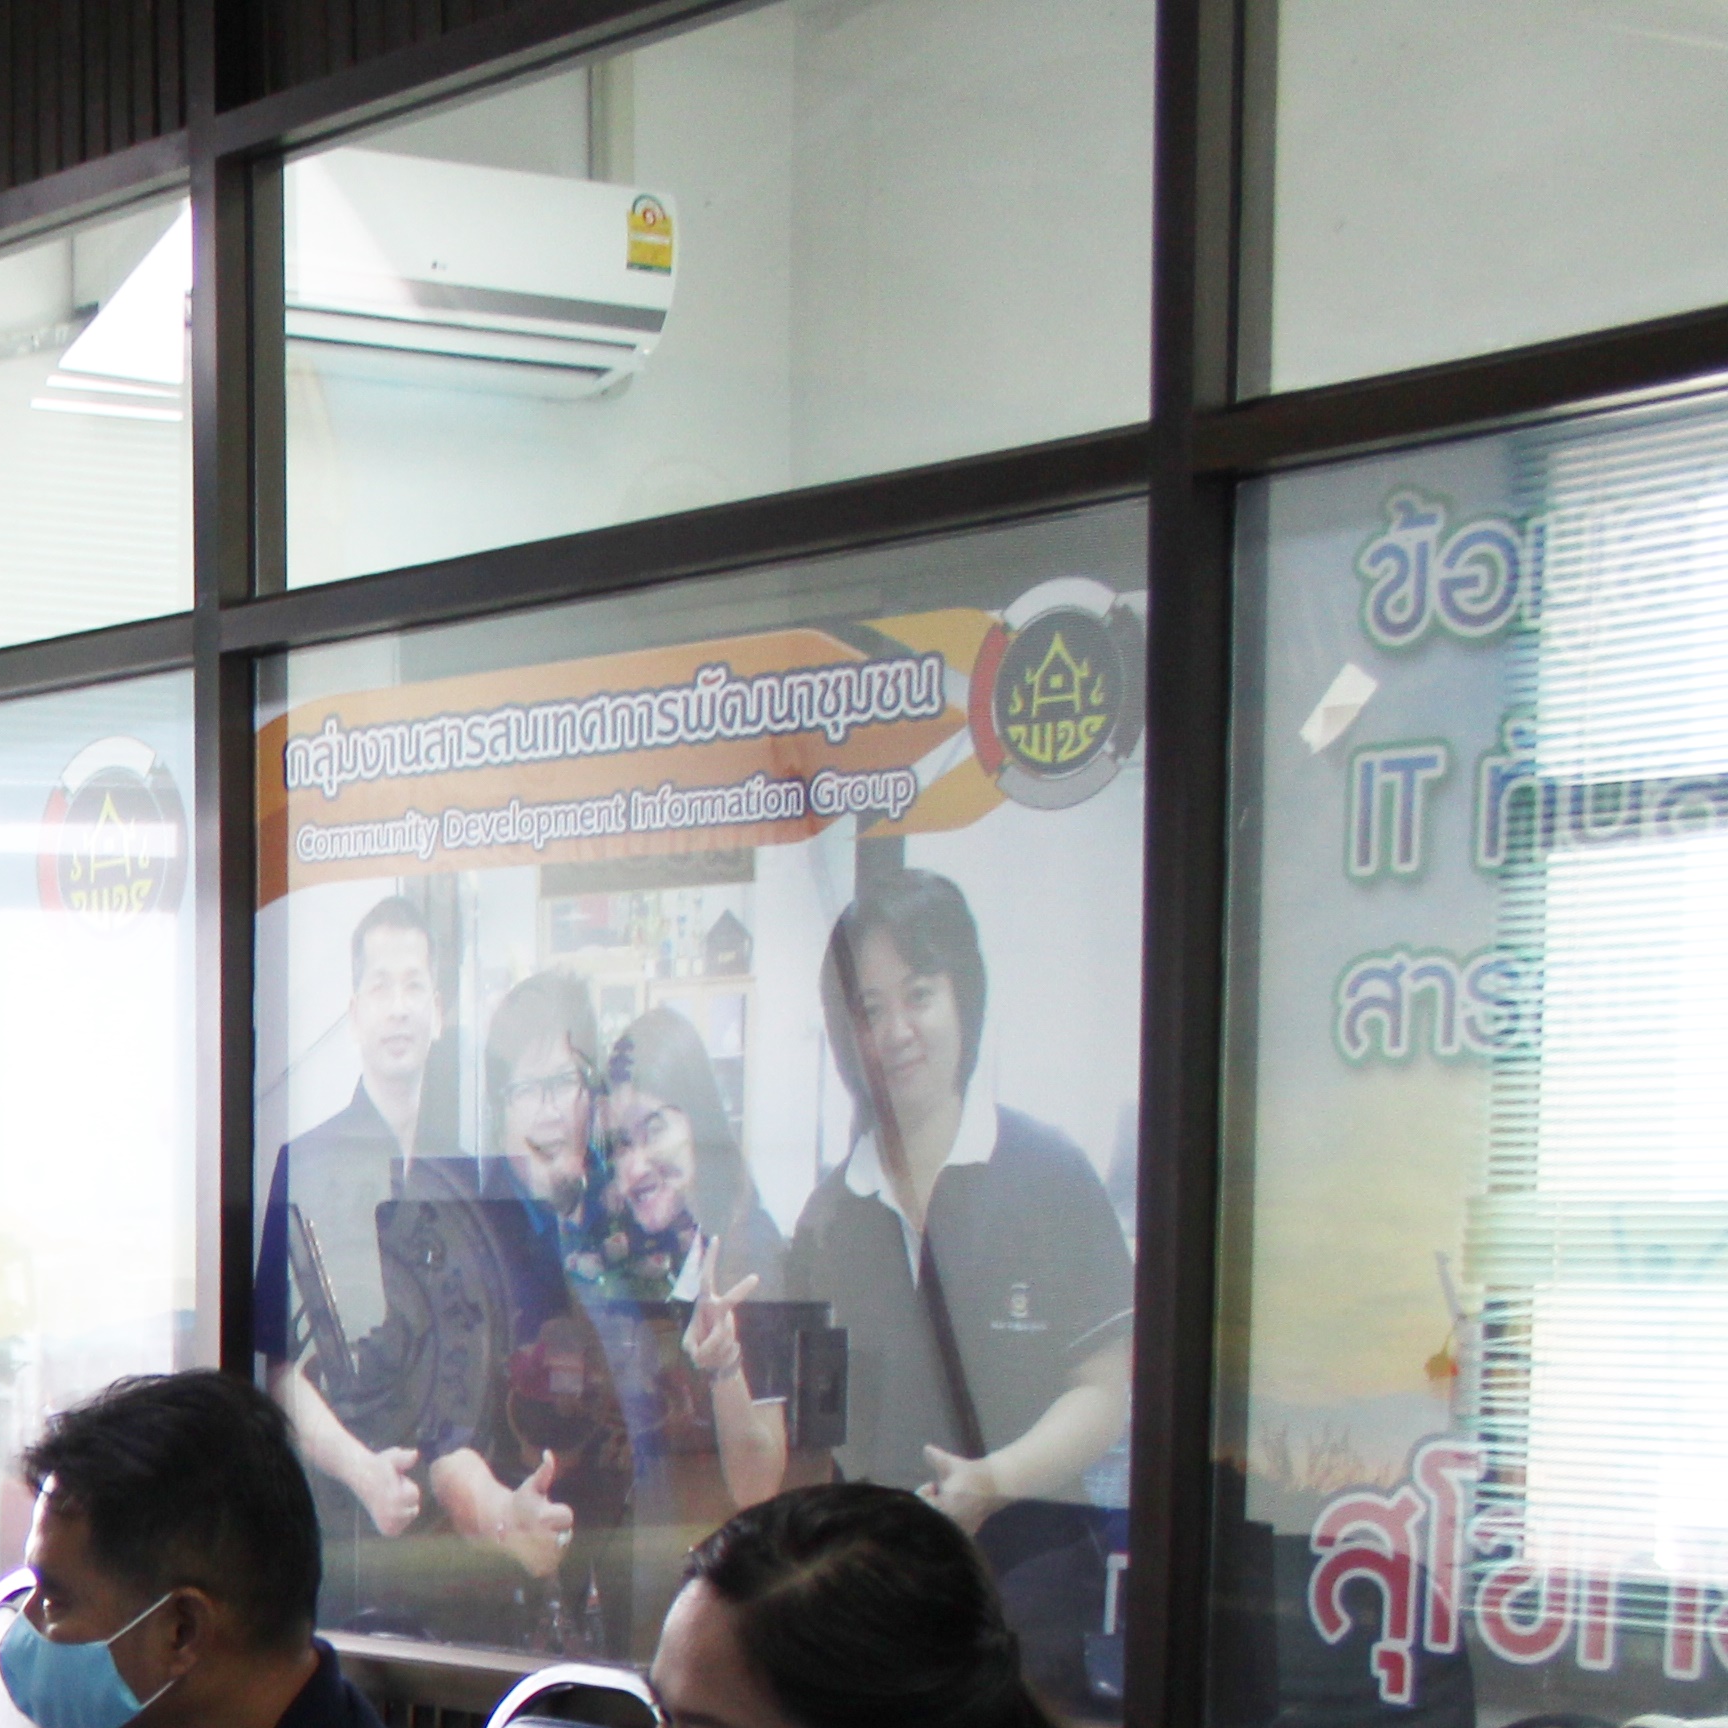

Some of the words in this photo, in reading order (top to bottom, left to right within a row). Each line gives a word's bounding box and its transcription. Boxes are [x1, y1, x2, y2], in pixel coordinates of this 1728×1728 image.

[285, 656, 942, 795] กลุ่มงานสารสนเทศการพัฒนาชุมชน
[296, 815, 438, 862] Community
[444, 796, 626, 850] Development
[631, 777, 806, 829] Information
[811, 767, 917, 818] Group
[1352, 748, 1446, 872] IT
